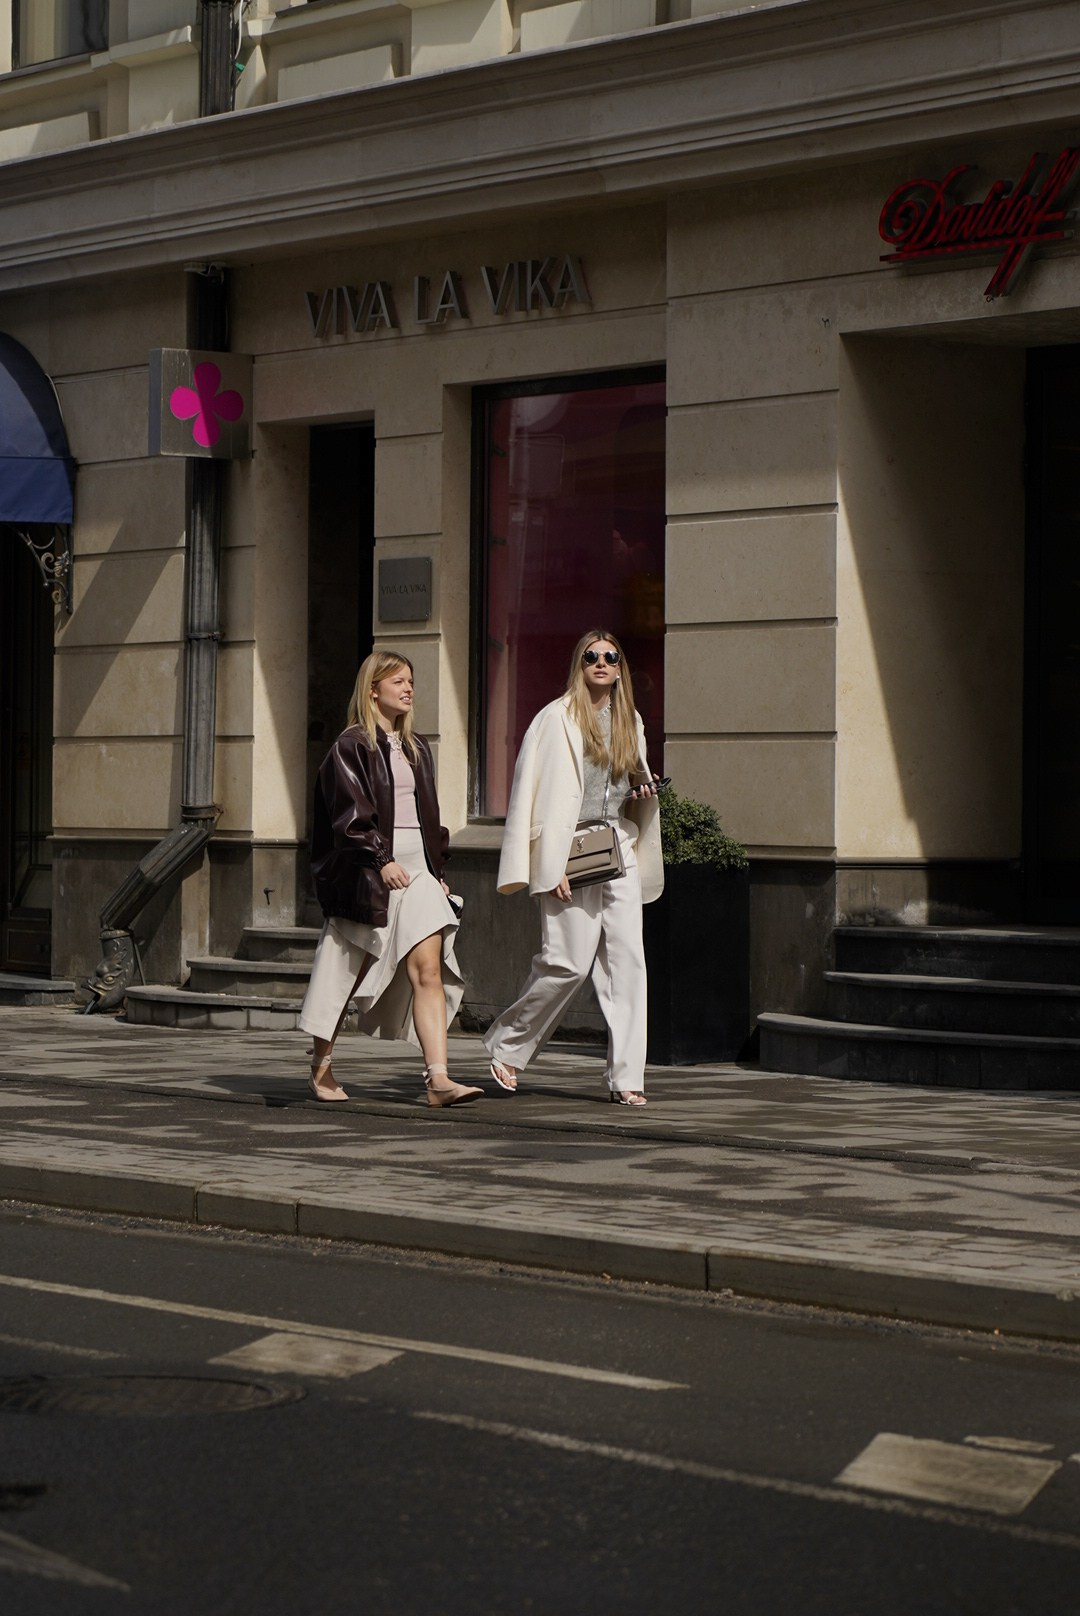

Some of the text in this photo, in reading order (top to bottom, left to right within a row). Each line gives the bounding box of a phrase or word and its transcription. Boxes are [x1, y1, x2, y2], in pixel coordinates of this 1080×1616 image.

[305, 255, 584, 338] VIVA LA VIKA
[399, 584, 408, 594] LA
